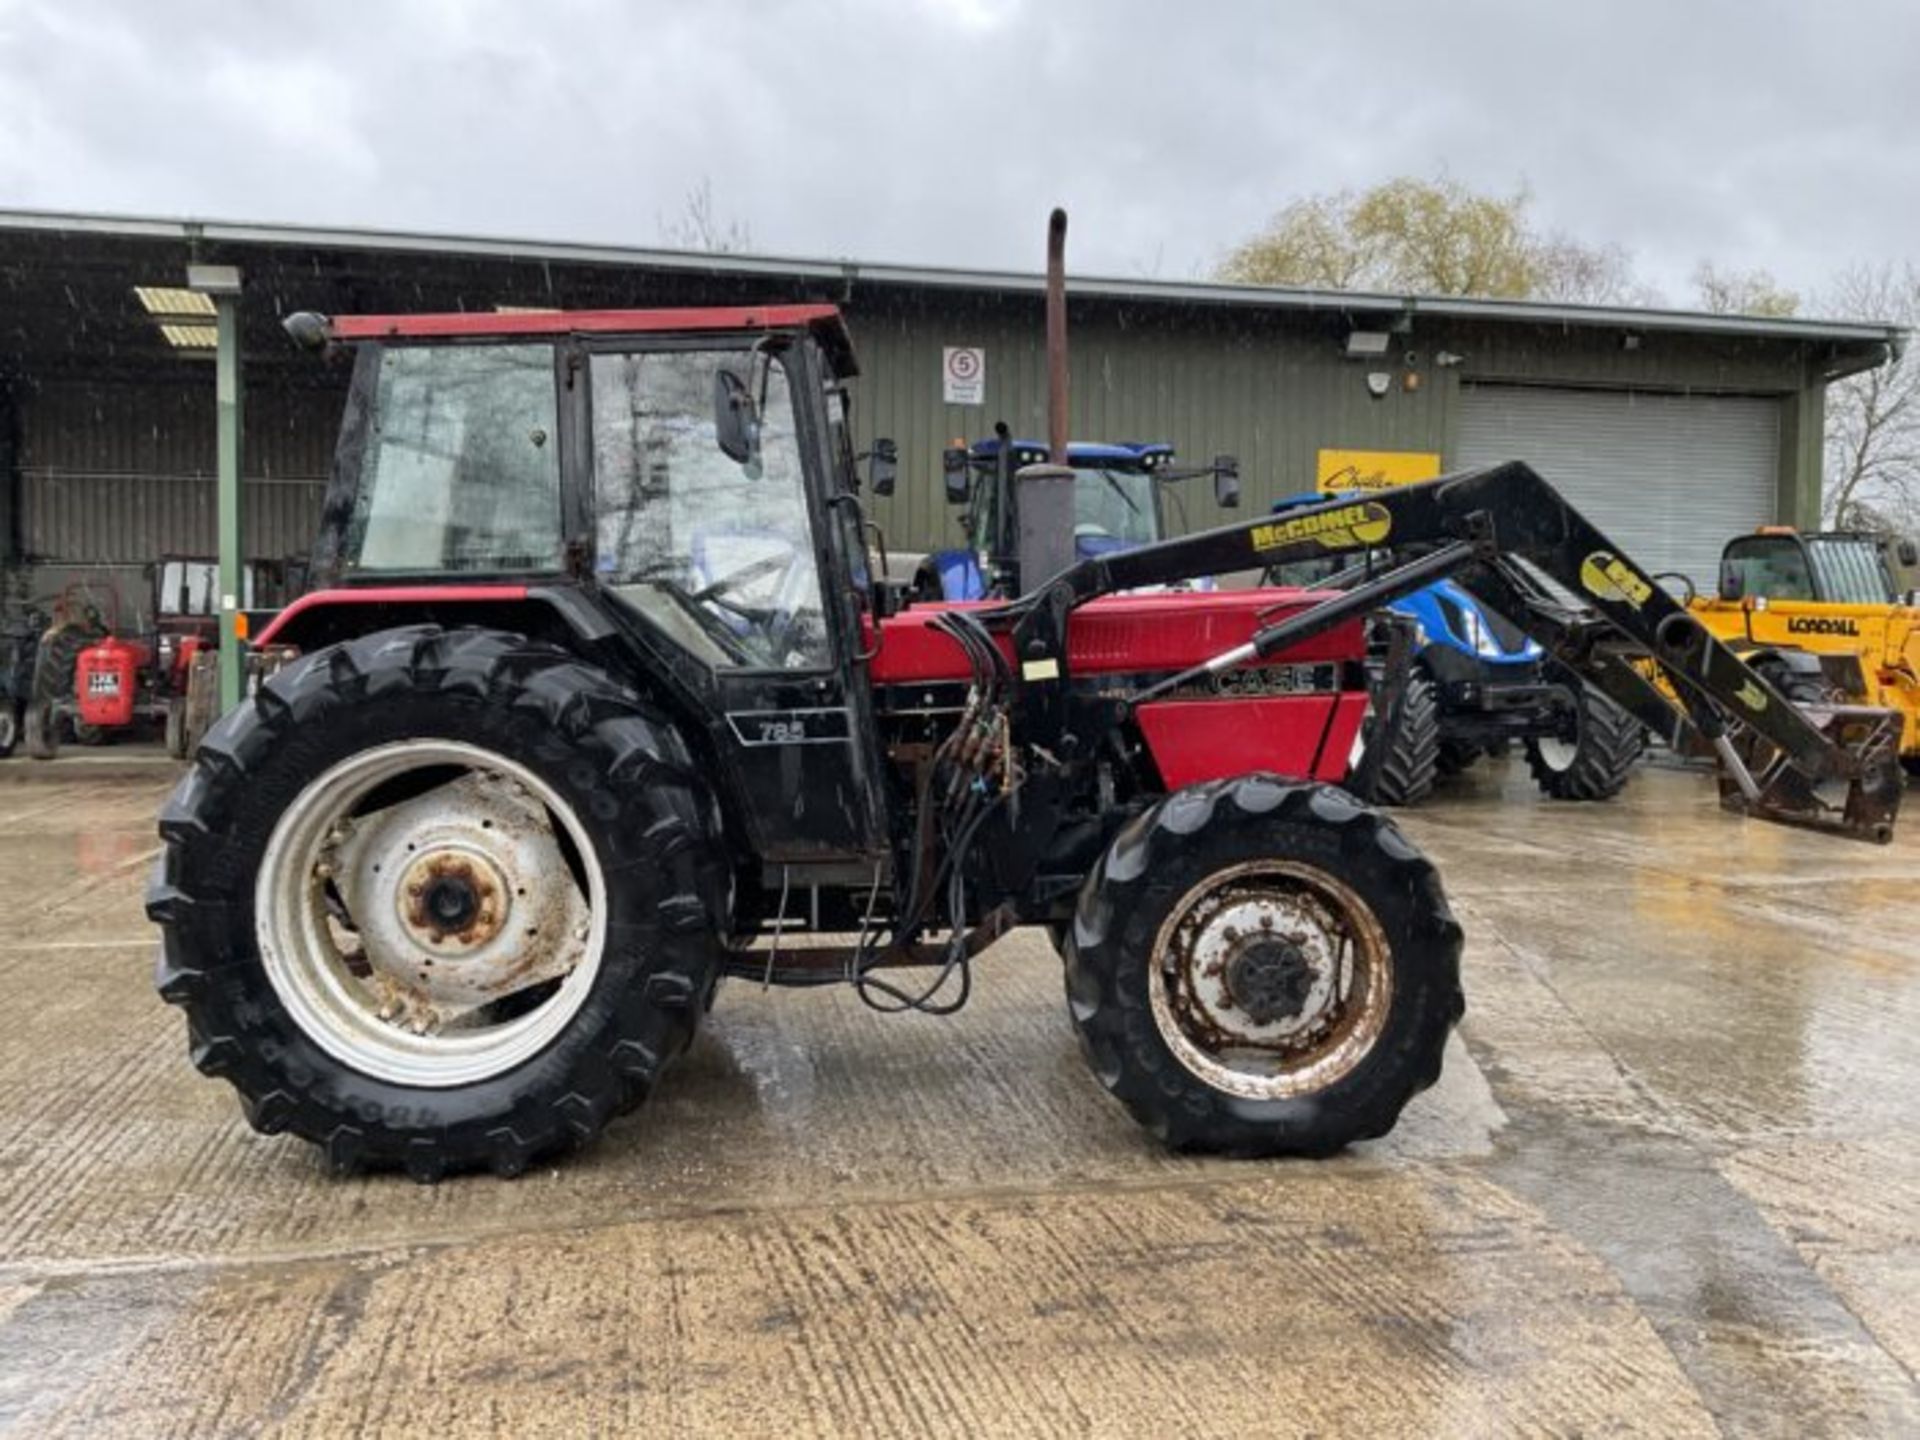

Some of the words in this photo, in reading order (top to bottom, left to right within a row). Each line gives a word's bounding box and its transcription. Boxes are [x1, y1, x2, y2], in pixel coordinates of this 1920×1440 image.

[958, 355, 971, 373] 5
[1787, 617, 1860, 637] LOADALL
[1213, 662, 1315, 697] CASE
